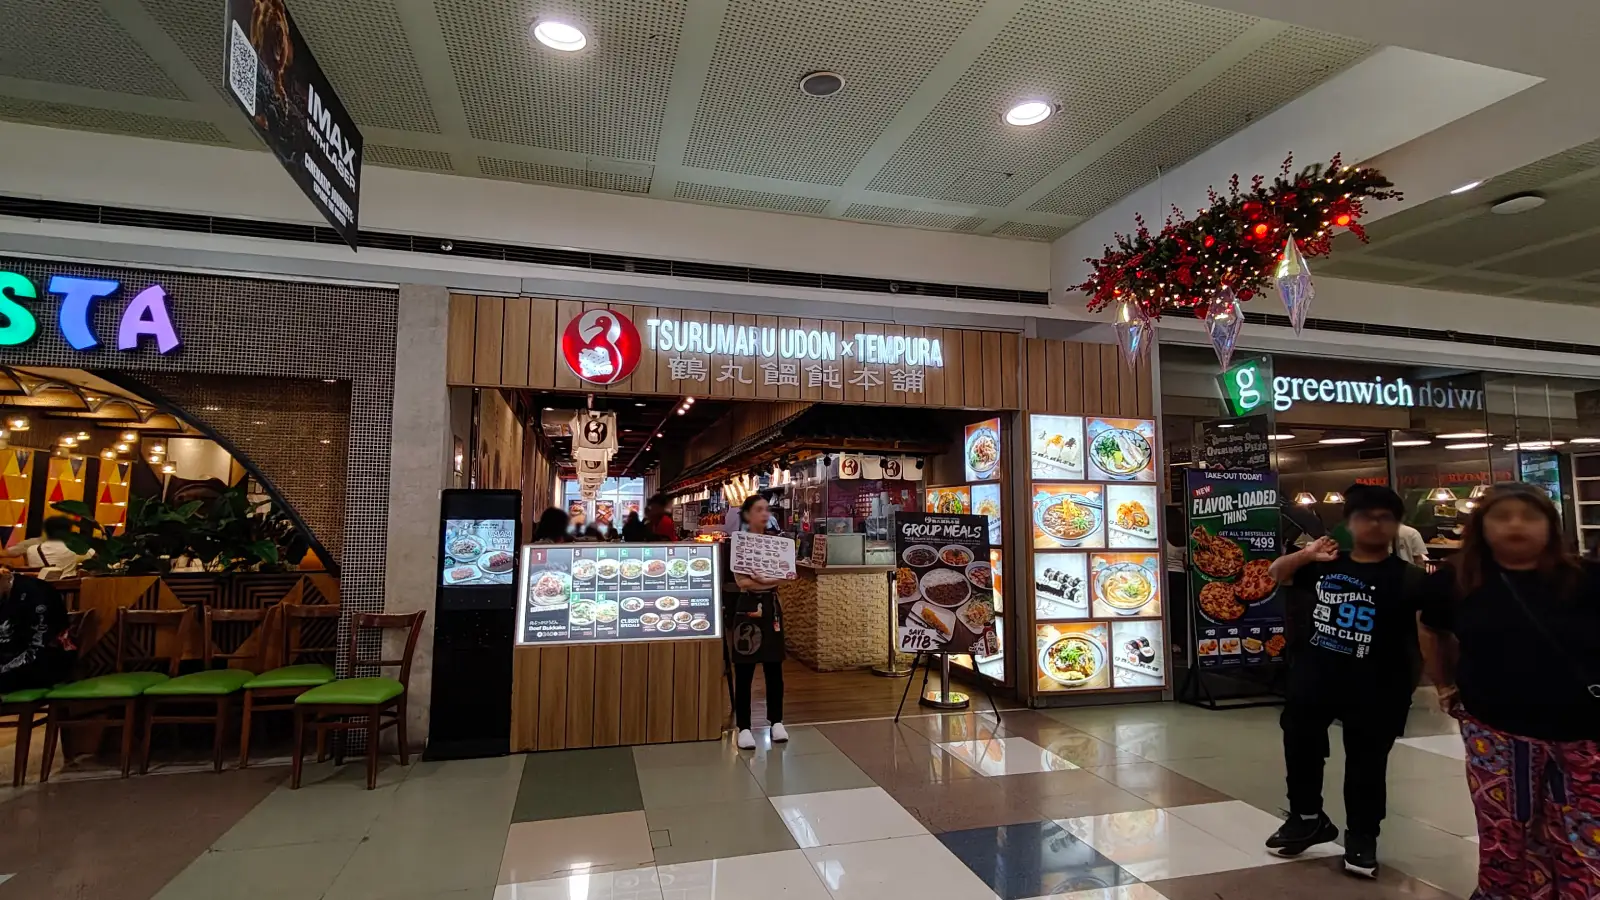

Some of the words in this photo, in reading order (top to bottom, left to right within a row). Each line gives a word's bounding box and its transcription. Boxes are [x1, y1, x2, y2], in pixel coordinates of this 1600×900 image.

[308, 83, 356, 176] IMAX
[307, 118, 326, 151] WITH
[326, 144, 356, 193] LASER
[0, 271, 179, 355] STA
[647, 319, 776, 358] TSURUMARU
[780, 328, 836, 361] UDON
[854, 333, 944, 368] TEMPURA
[1236, 367, 1260, 409] g
[1272, 376, 1414, 411] greenwich
[1196, 486, 1211, 496] NEW
[1204, 472, 1236, 480] TAKE-OUT
[1239, 472, 1262, 480] TODAY!
[1193, 490, 1276, 514] FLAVOR-LOADED
[1222, 509, 1248, 525] THINS
[902, 523, 942, 537] GROUP
[944, 524, 982, 538] MEALS
[1336, 602, 1376, 632] 95
[1338, 630, 1372, 643] CLUB
